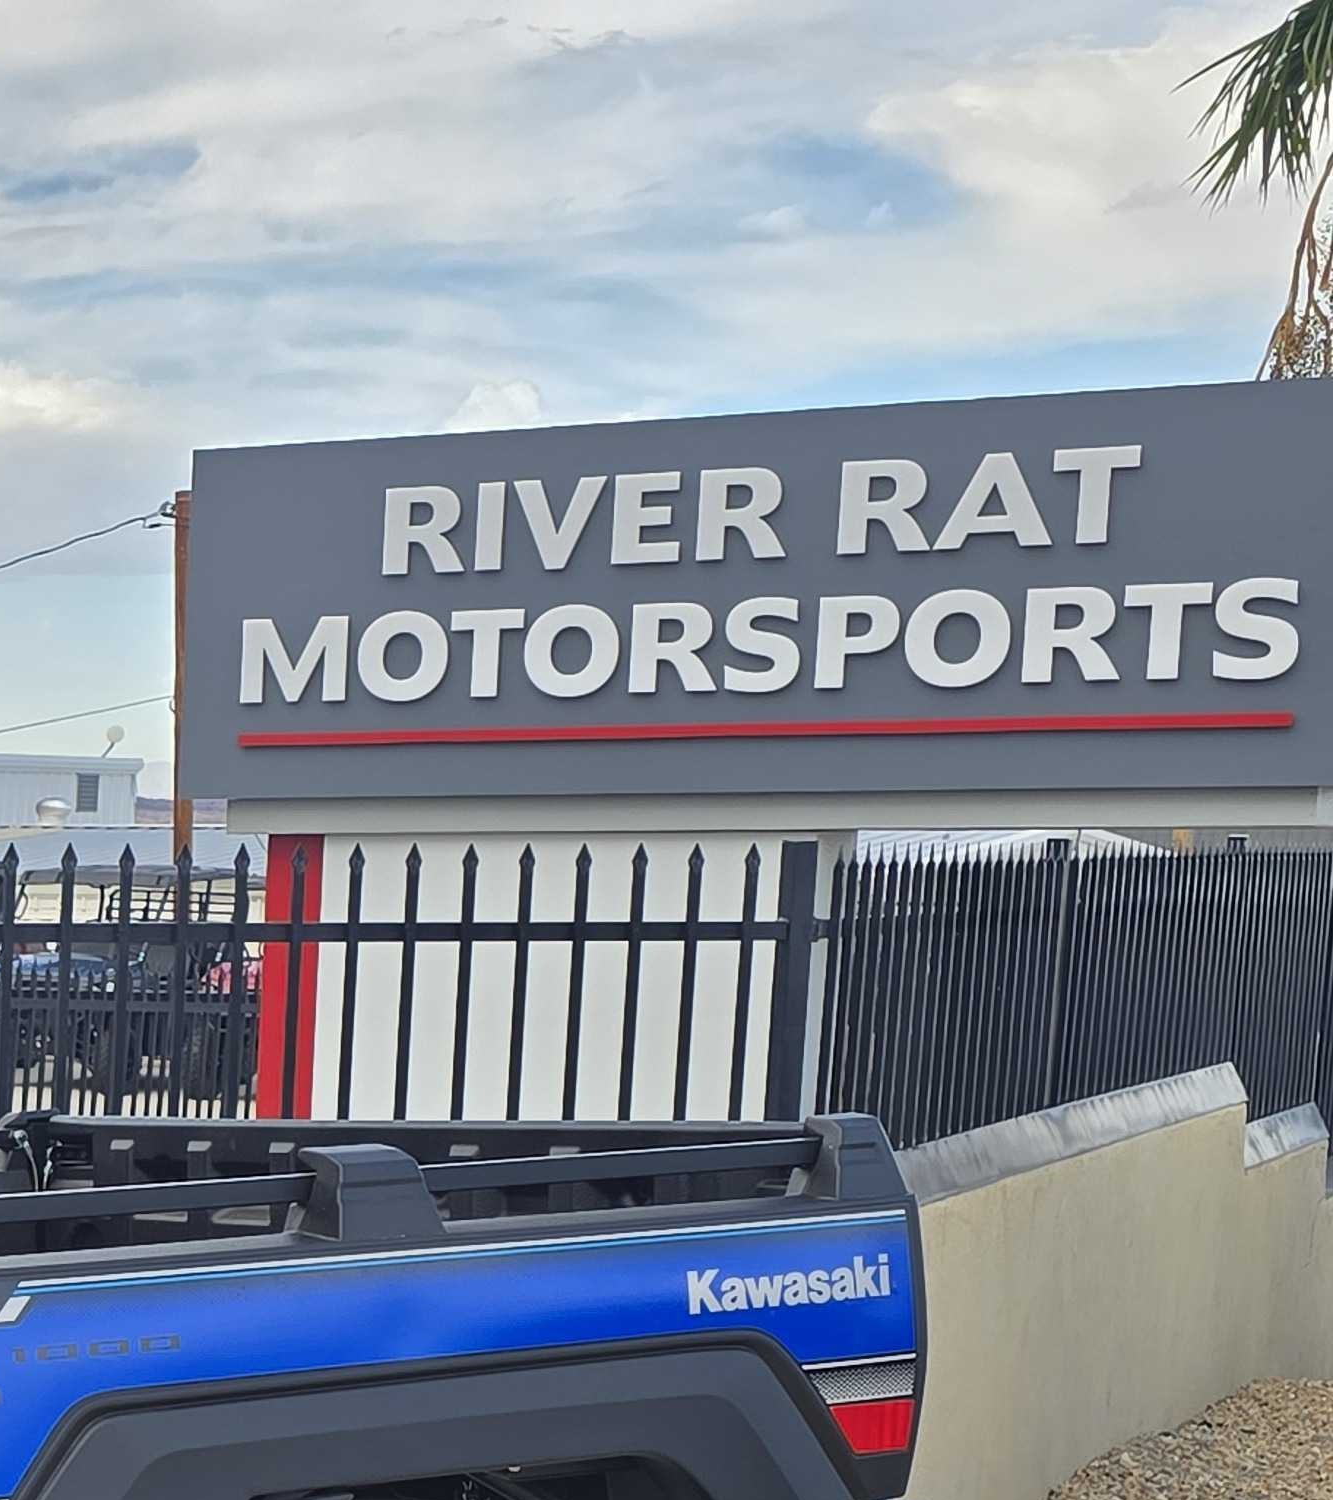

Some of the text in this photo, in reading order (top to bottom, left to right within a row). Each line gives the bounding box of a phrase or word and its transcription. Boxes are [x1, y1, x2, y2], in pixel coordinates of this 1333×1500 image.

[381, 444, 1143, 576] RIVER RAT
[239, 576, 1300, 704] MOTORSPORTS
[686, 1253, 891, 1315] Kawasaki
[12, 1335, 182, 1364] 1000
